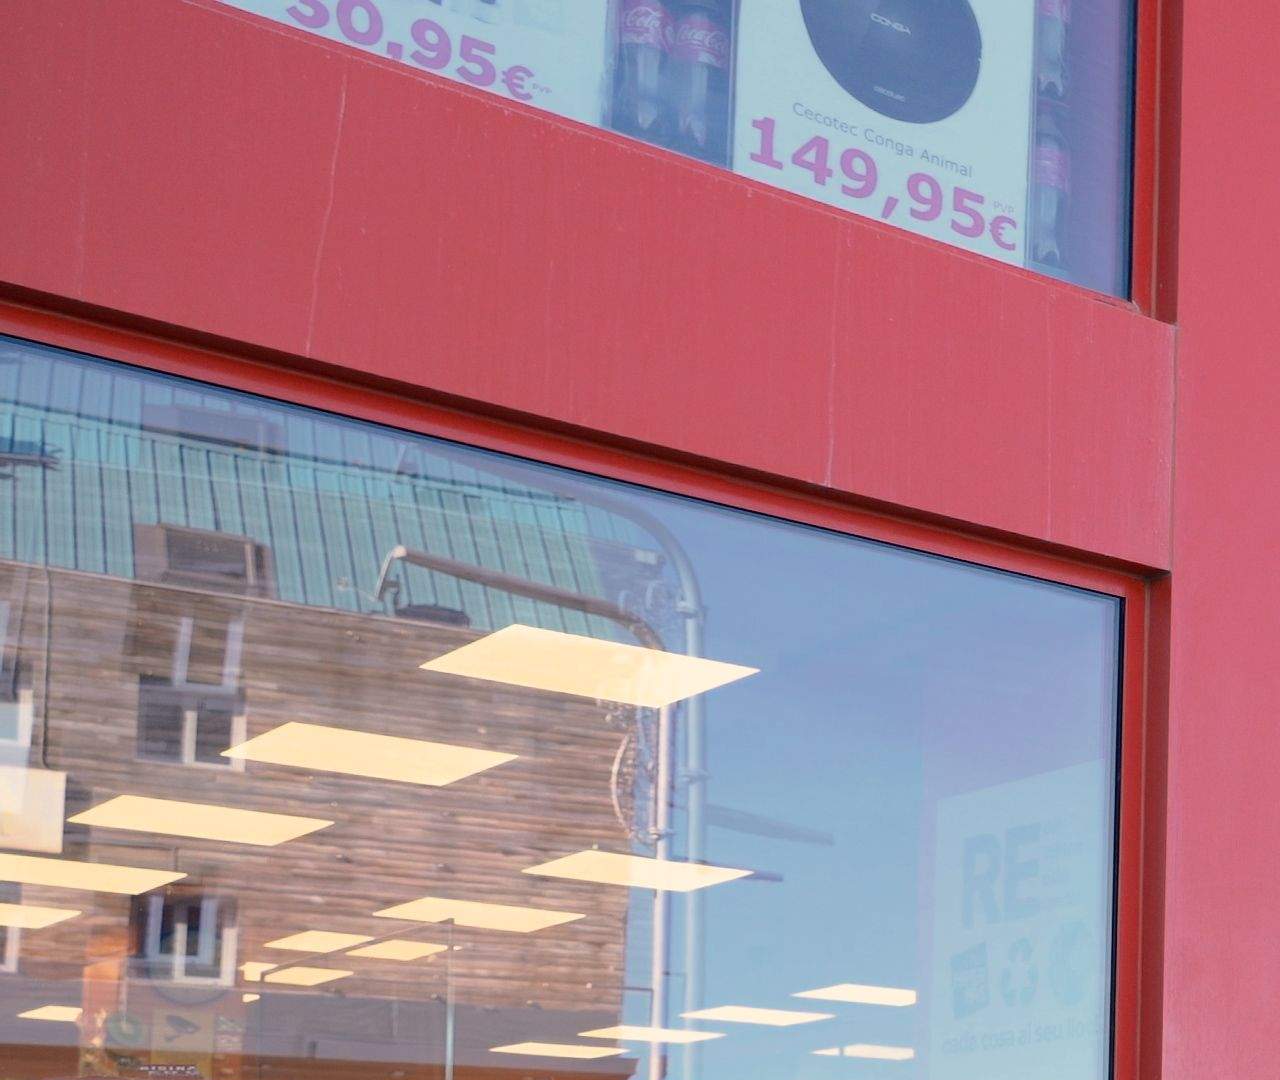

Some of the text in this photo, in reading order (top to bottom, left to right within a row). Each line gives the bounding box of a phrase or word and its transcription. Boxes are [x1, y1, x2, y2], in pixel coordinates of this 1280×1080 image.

[793, 102, 973, 179] Cecotec Conga Animal
[750, 116, 1017, 252] 149,95€
[993, 199, 1015, 214] PVP
